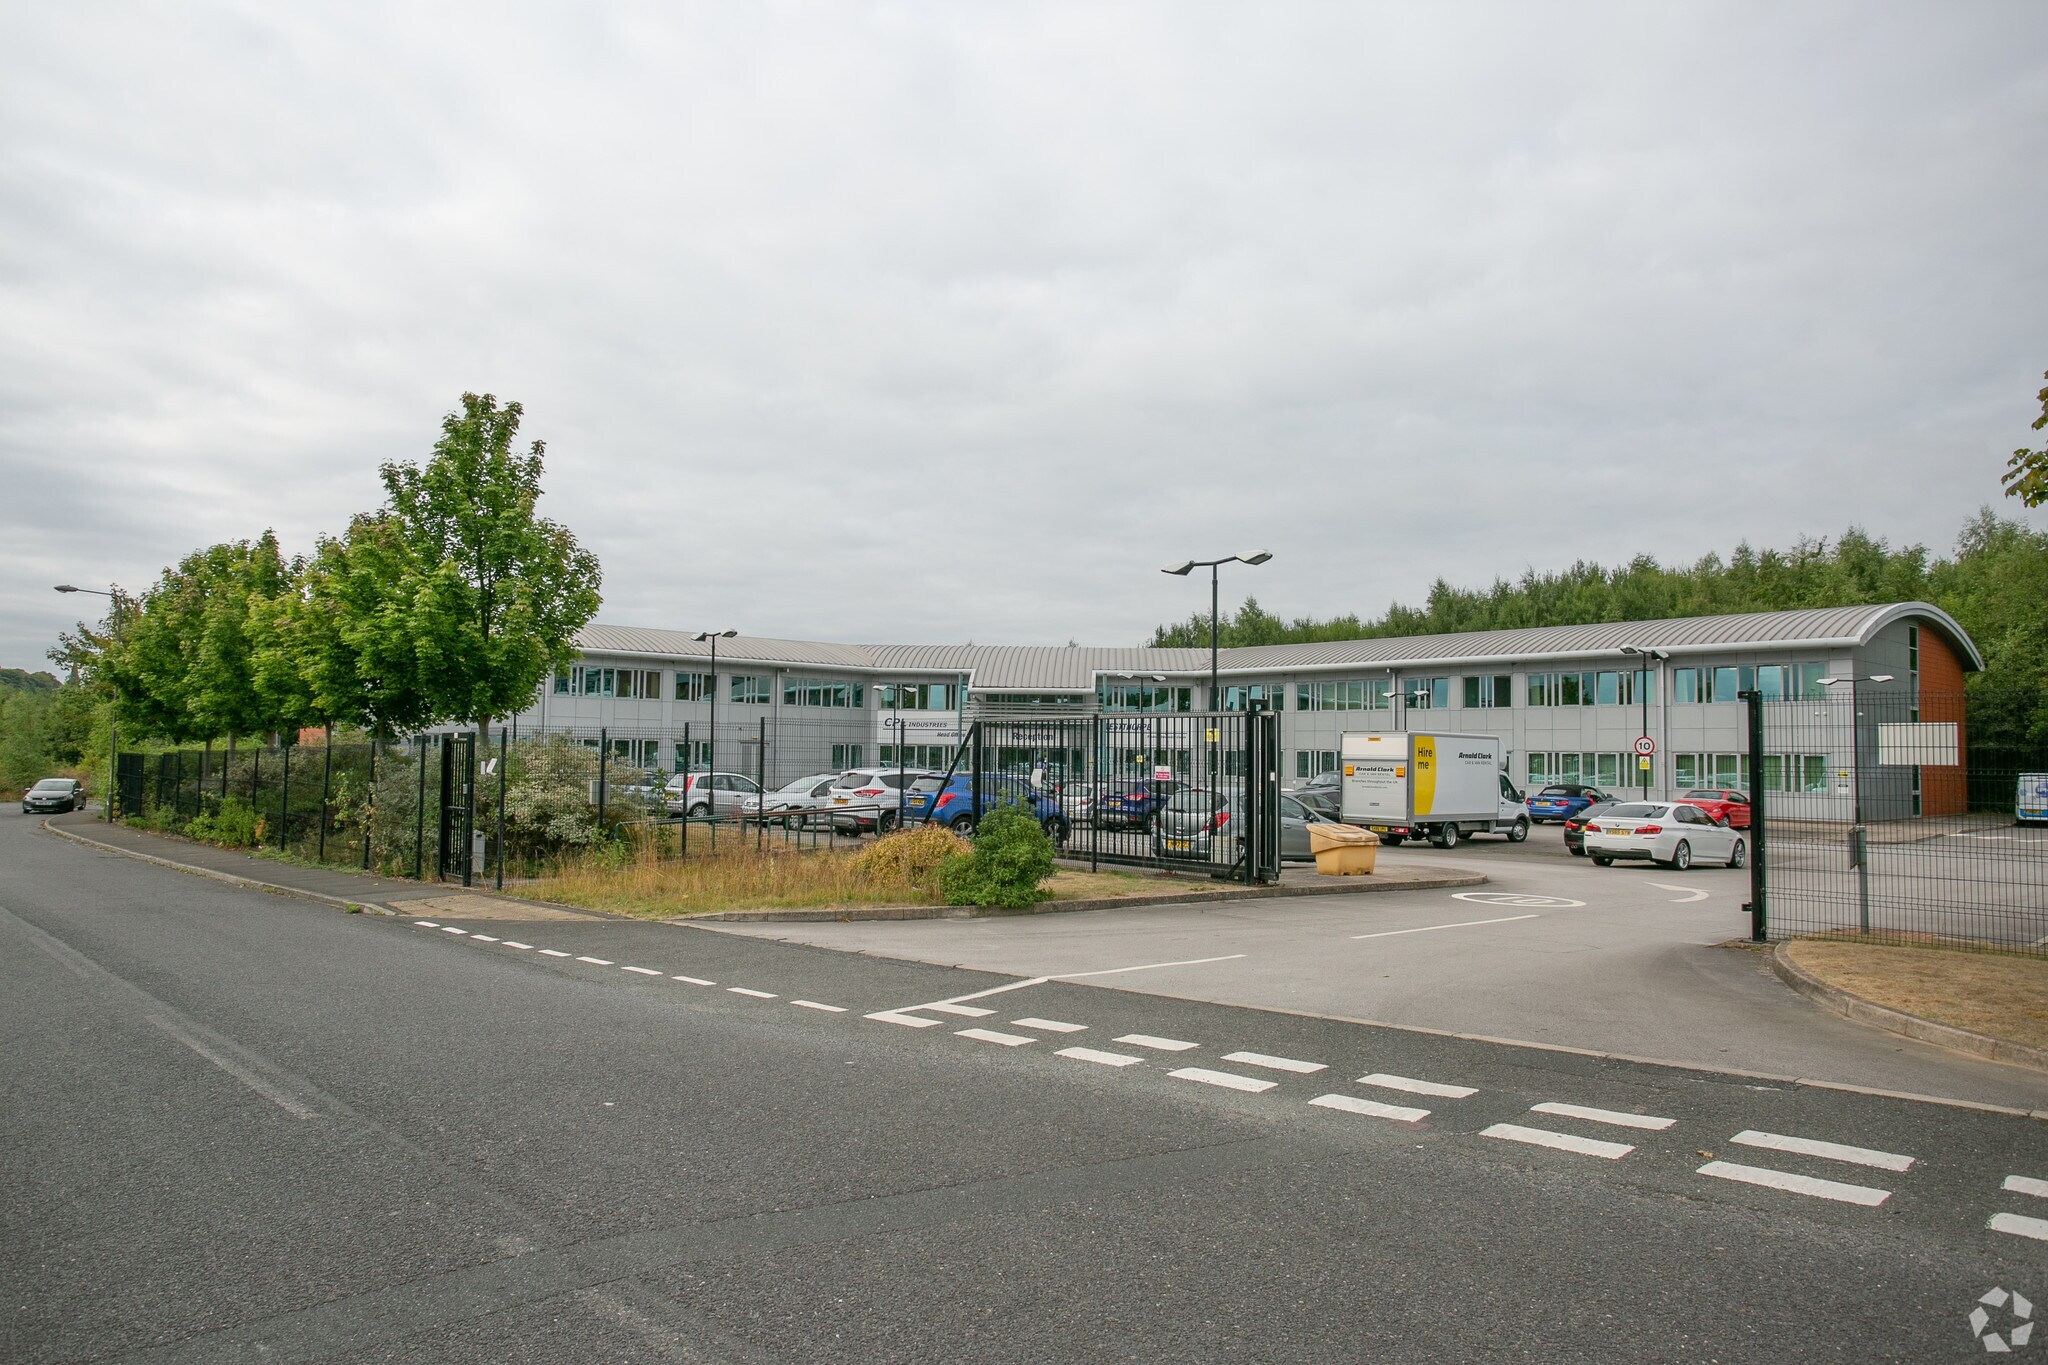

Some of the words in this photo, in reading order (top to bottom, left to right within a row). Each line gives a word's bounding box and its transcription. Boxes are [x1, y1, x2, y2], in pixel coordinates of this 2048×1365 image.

[1639, 742, 1651, 750] 10
[1417, 747, 1433, 757] Hire
[1418, 761, 1429, 769] me
[1487, 896, 1558, 904] 10
